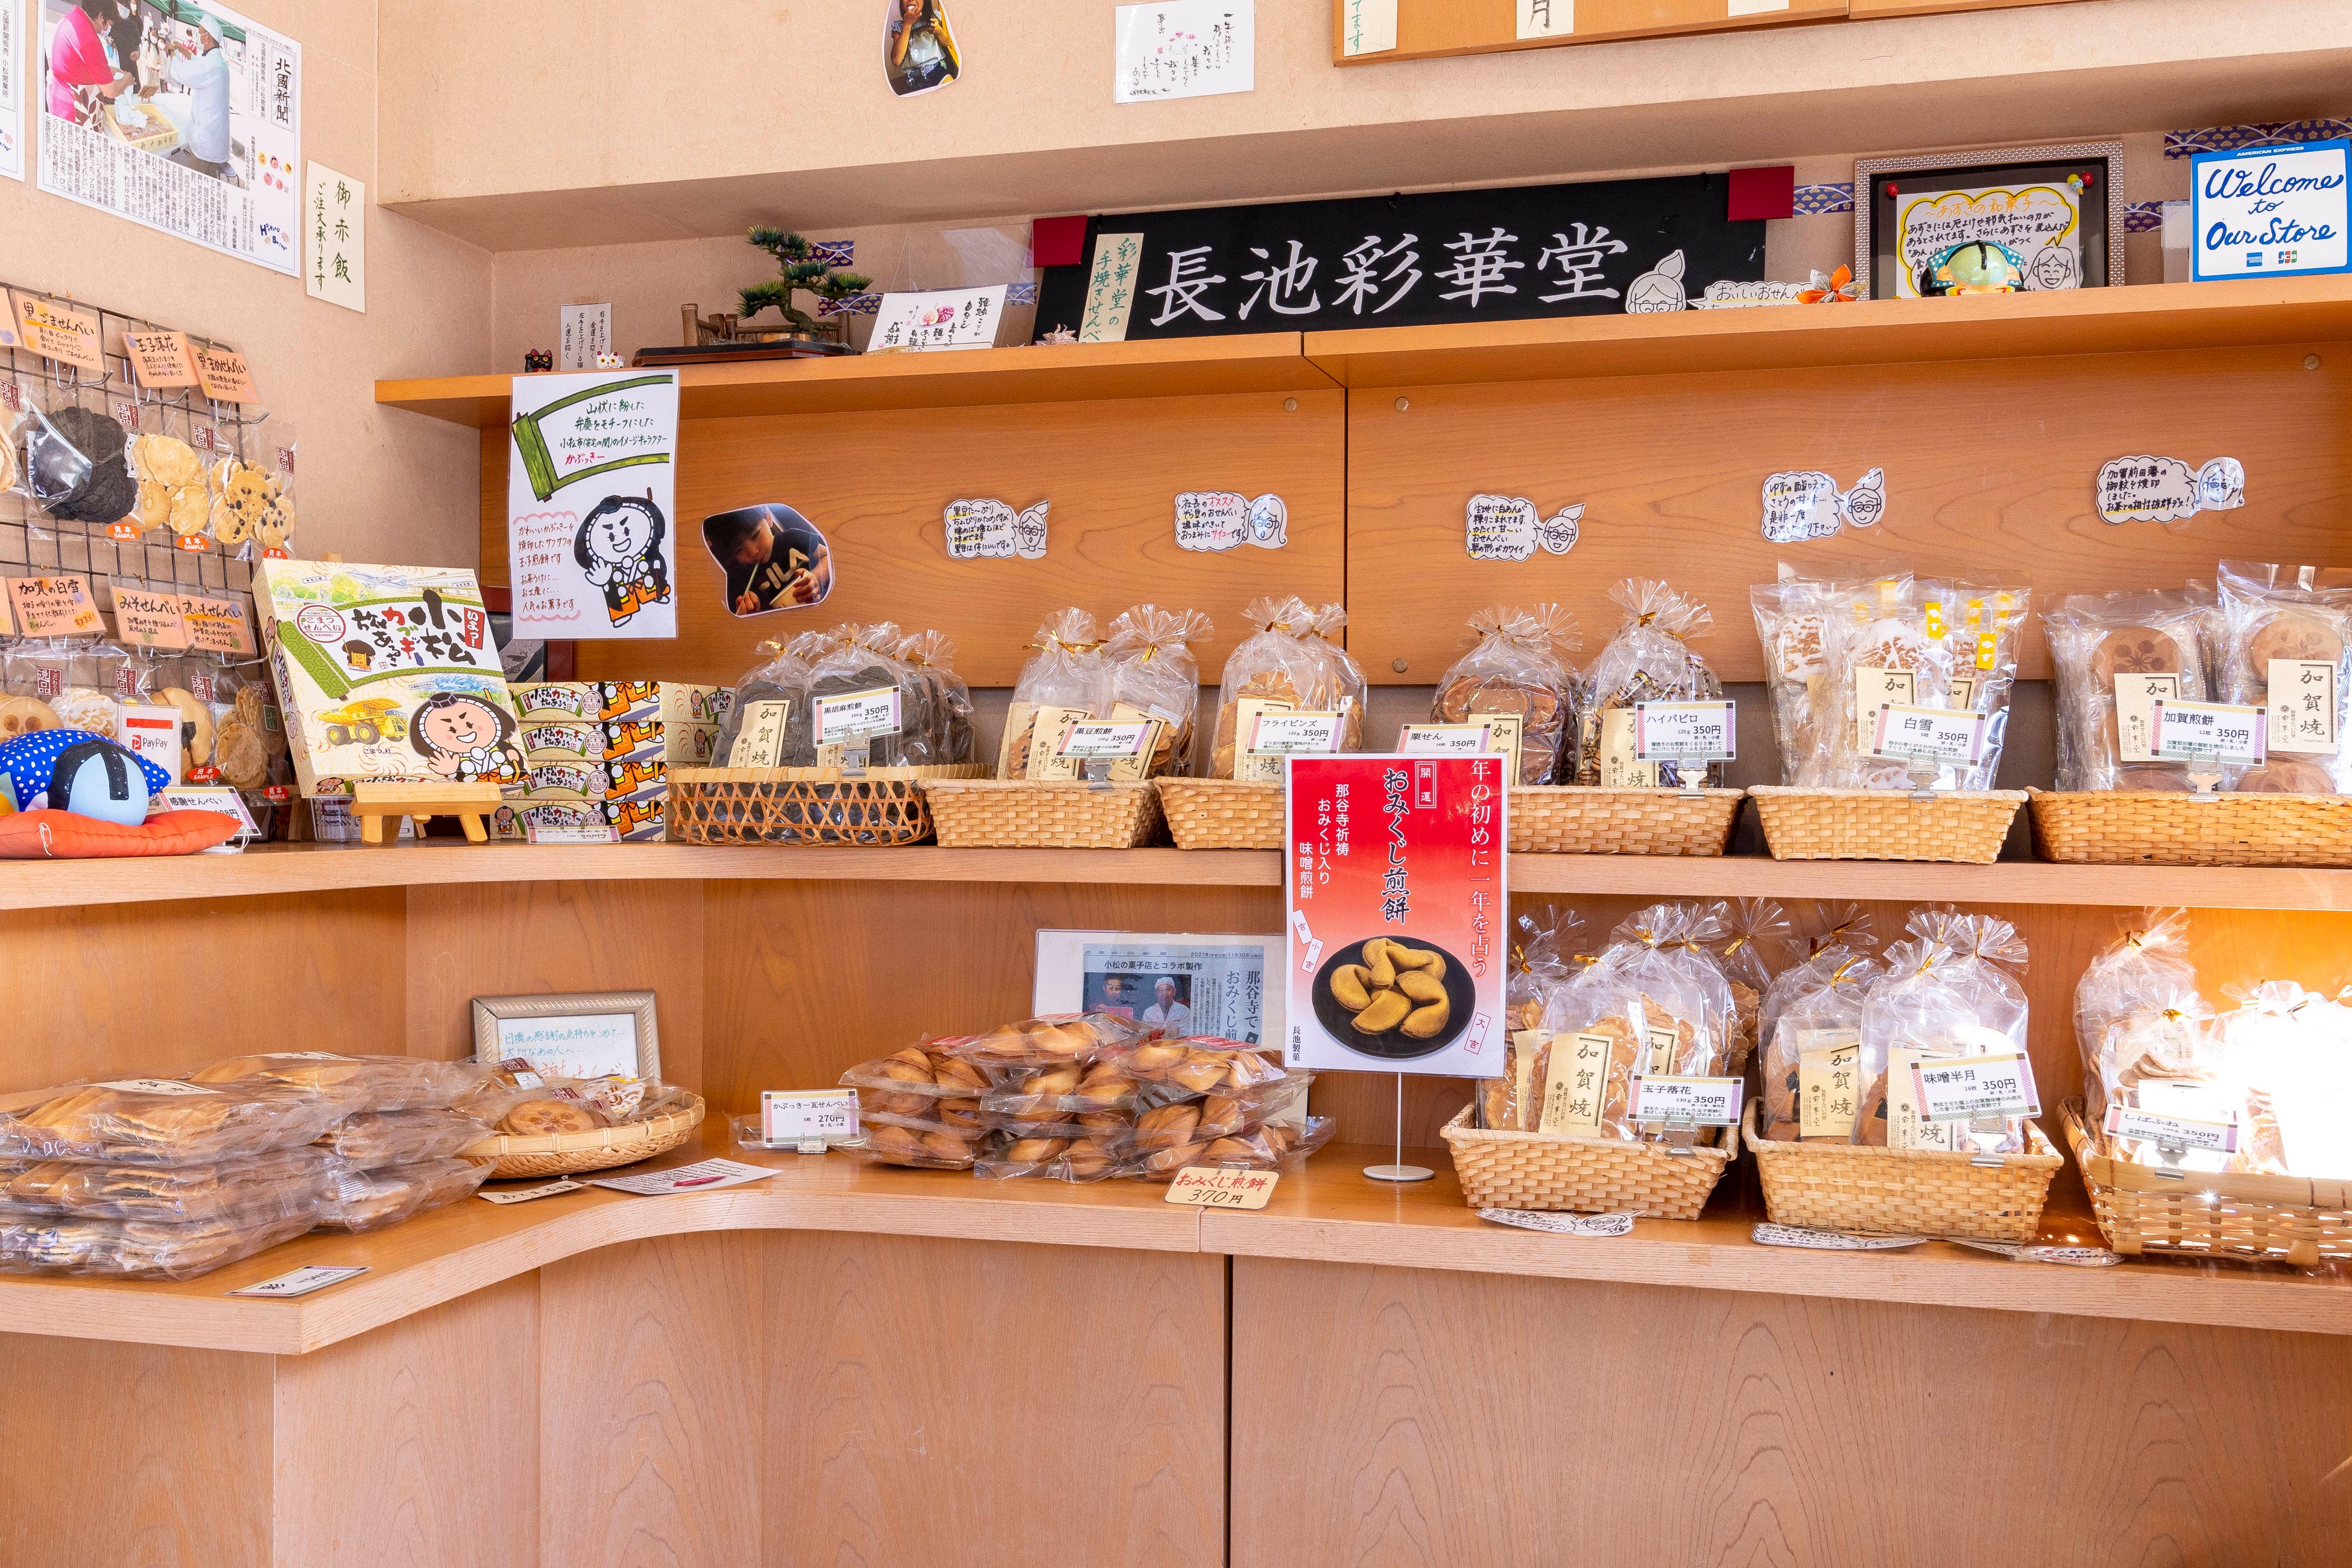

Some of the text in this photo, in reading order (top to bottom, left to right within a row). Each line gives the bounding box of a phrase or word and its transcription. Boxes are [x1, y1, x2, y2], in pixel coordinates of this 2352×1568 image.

[274, 57, 292, 124] 北國新聞
[2205, 163, 2344, 198] Welcome
[2248, 198, 2284, 215] to
[314, 182, 326, 291] ご注文承ります
[331, 180, 351, 283] 御赤飯
[2206, 217, 2336, 250] Our Store
[2278, 250, 2298, 264] JCB
[1108, 238, 1137, 326] 彩華堂の
[1146, 223, 1627, 326] 長池彩華堂
[24, 302, 95, 335] 黒ごませんべい
[136, 334, 178, 352] 玉子落花
[197, 352, 247, 375] 黒まめせんべい
[575, 417, 654, 431] 弁慶をモチーフにした
[565, 452, 605, 465] かぶっきー
[1181, 496, 1235, 509] 社長のオススメ
[1472, 534, 1508, 542] おせんべい
[519, 554, 561, 567] 玉子煎餅です
[18, 579, 79, 596] 加賀の白雪
[120, 596, 180, 615] みそせんべい
[182, 599, 242, 618] 丸いもせんべい
[522, 598, 575, 614] 人気のお菓子です
[408, 589, 476, 666] 小松
[37, 669, 50, 694] 逸品
[116, 669, 127, 694] 逸品
[824, 702, 862, 714] 黒胡麻煎餅
[864, 705, 890, 716] 350円
[2300, 670, 2325, 735] 加賀焼
[1904, 717, 1933, 731] 白雪
[2163, 712, 2214, 726] 加賀煎餅
[751, 708, 777, 765] 加賀焼
[1693, 726, 1721, 735] 350円
[1937, 732, 1968, 743] 350円
[2216, 729, 2249, 739] 350円
[143, 738, 168, 750] PayPay
[1420, 767, 1431, 802] 開運
[169, 797, 223, 806] 感謝せんべい
[1336, 784, 1349, 856] 那谷寺祈祷
[1317, 798, 1331, 885] おみくじ入り
[1381, 768, 1411, 924] おみくじ煎餅
[1300, 842, 1313, 899] 味噌煎餅
[1470, 759, 1491, 977] 年の初めに一年を占う
[1298, 922, 1306, 932] 吉
[1104, 960, 1202, 971] 小松の菓子店とコラボ製作
[1244, 970, 1260, 1029] 那谷寺で
[1468, 1017, 1487, 1049] 大吉
[1292, 1026, 1301, 1061] 長池製菓
[1570, 1044, 1599, 1117] 加賀焼
[1830, 1055, 1854, 1116] 加賀焼
[1924, 1070, 1975, 1085] 味噌半月
[1982, 1078, 2016, 1090] 350円
[1642, 1085, 1692, 1095] 玉子落花
[773, 1101, 849, 1109] かぶっきー瓦せんべい
[1693, 1096, 1725, 1104] 350円
[2125, 1114, 2179, 1127] しばふね
[2183, 1129, 2219, 1139] 350円
[1176, 1172, 1268, 1192] おみくじ煎餅
[1188, 1189, 1244, 1204] 370円
